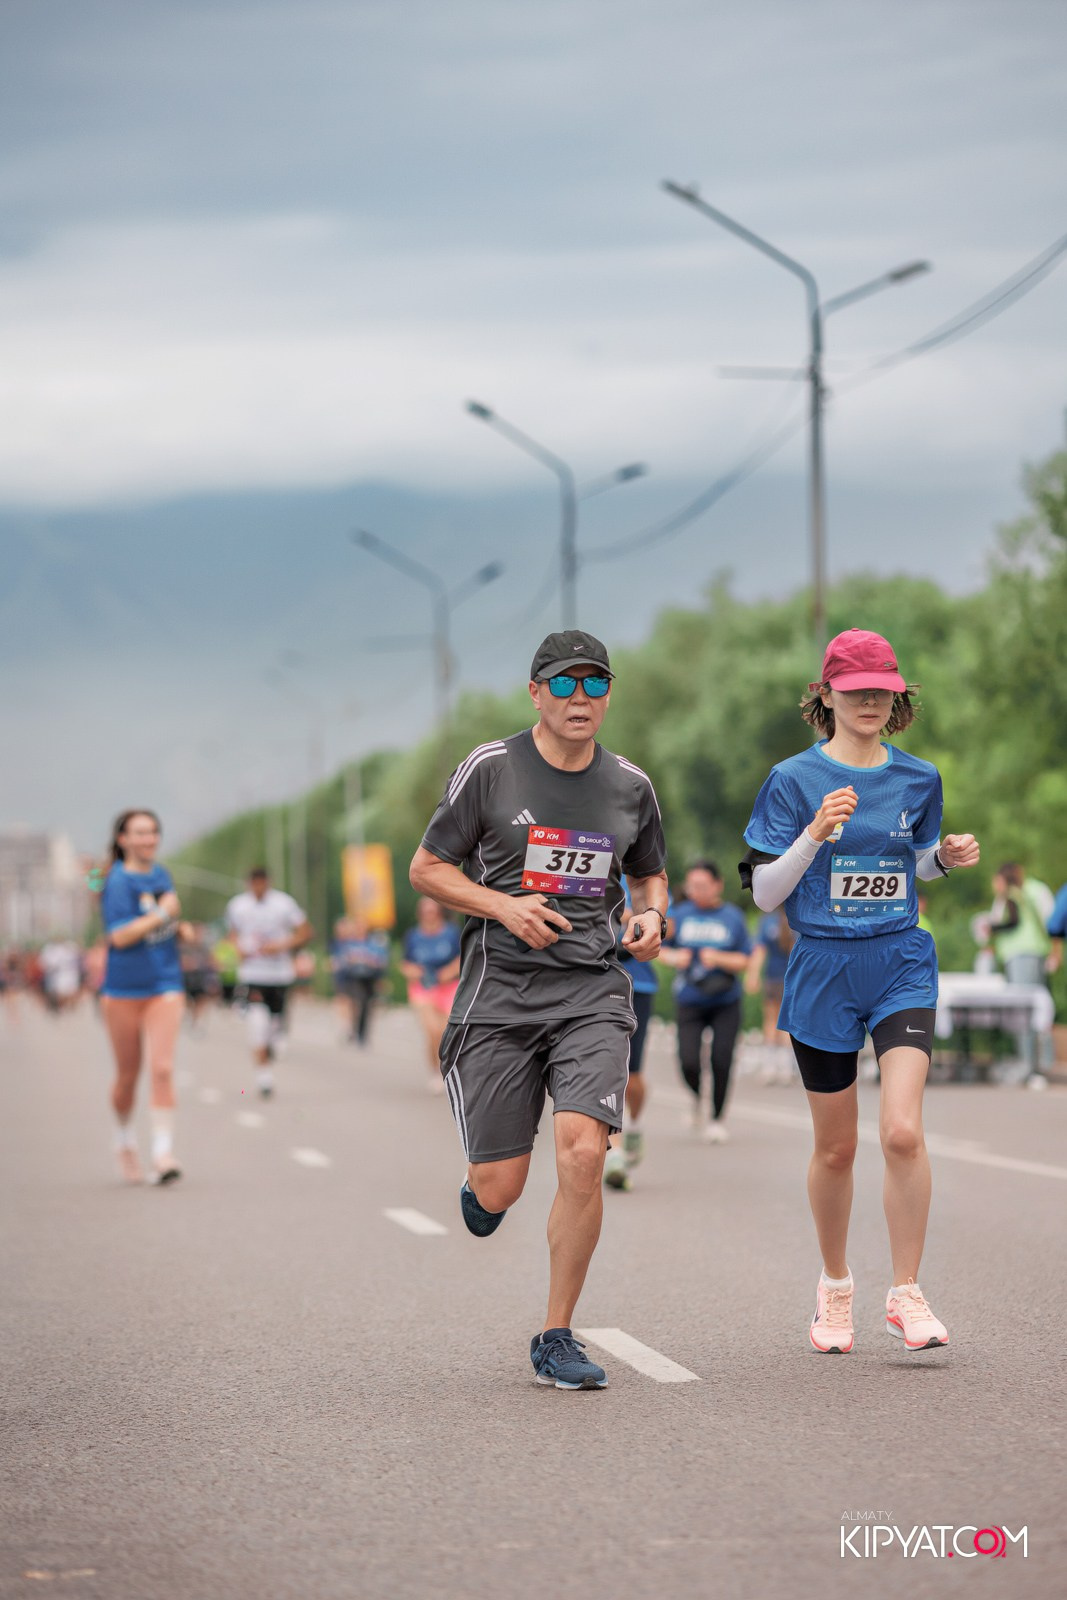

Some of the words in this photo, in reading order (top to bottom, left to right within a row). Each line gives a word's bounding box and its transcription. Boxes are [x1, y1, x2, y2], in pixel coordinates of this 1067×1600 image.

[533, 830, 545, 838] 10
[545, 849, 596, 874] 313
[842, 876, 898, 897] 1289
